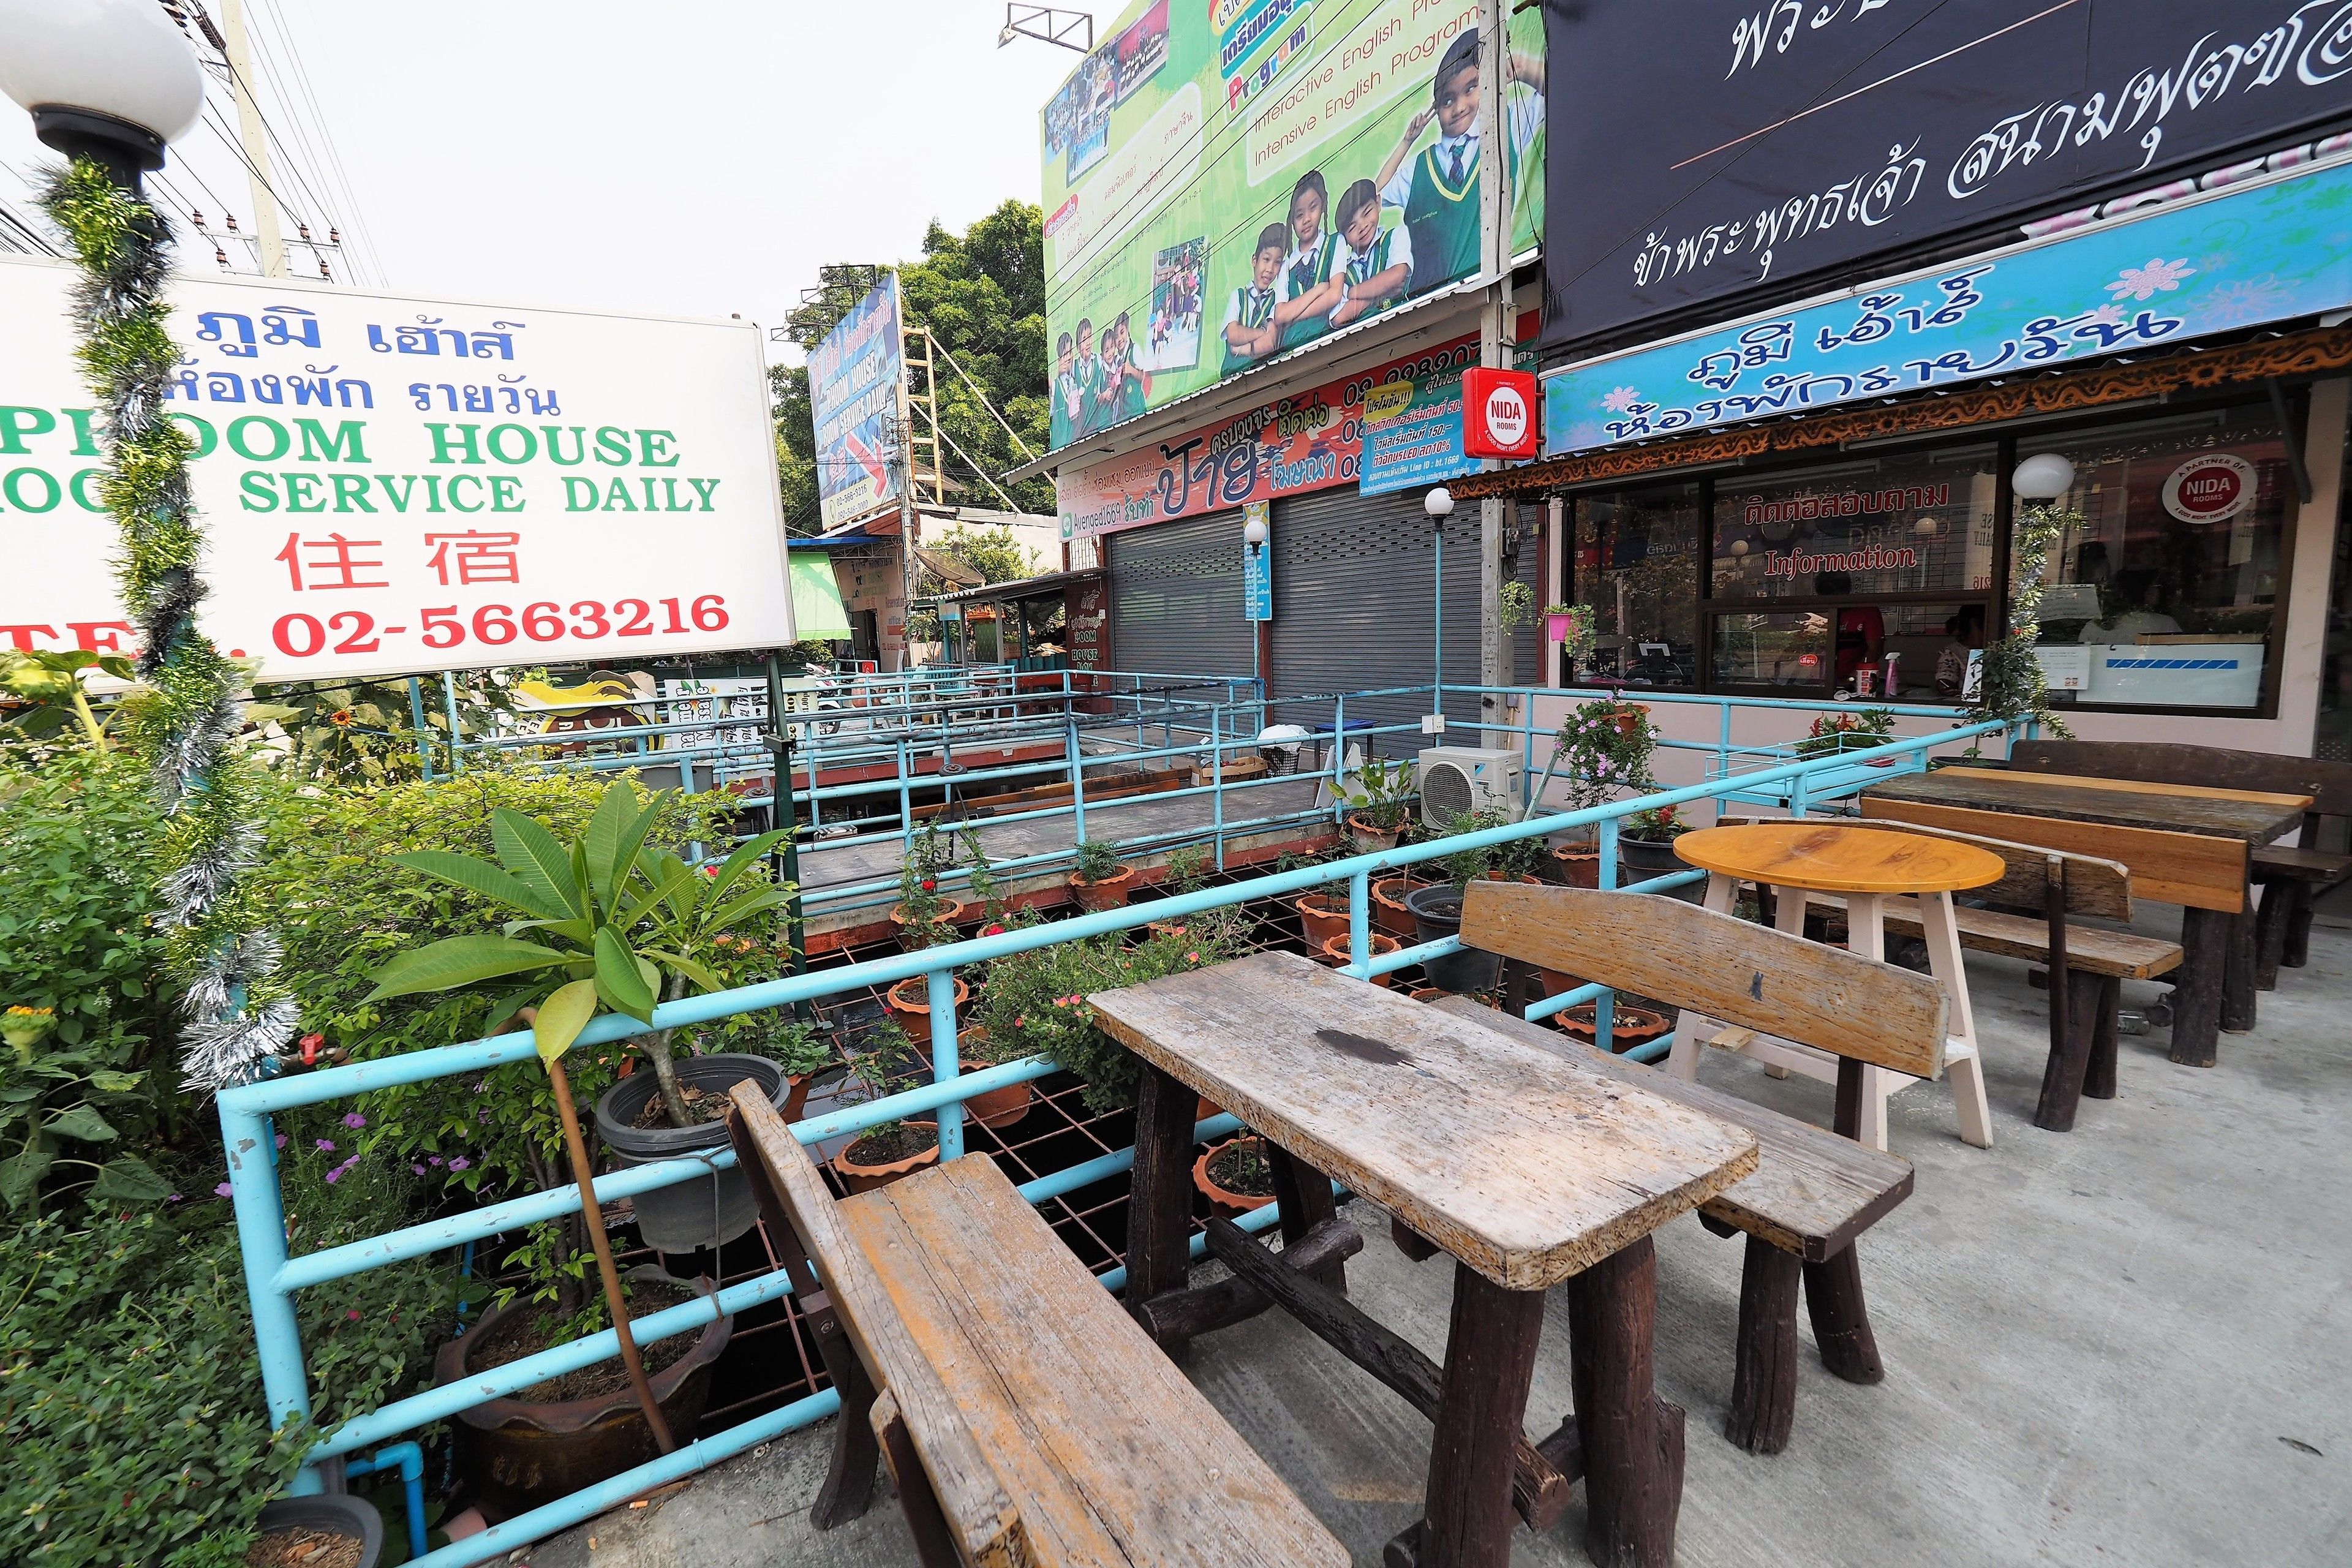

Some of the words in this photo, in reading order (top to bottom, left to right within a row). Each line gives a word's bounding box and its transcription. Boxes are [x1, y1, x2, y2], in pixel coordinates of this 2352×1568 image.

[1229, 26, 1305, 111] Program
[1255, 67, 1333, 133] Interactive
[1343, 18, 1401, 71] English
[1255, 116, 1316, 167] Intensive
[1325, 71, 1381, 119] English
[1392, 6, 1479, 75] Program
[196, 306, 322, 358] ภูมิ
[366, 314, 526, 360] เฮ้าส์
[162, 356, 374, 409] ห้องพัก
[408, 373, 562, 417] รายวัน
[826, 373, 850, 415] PHOOM
[851, 350, 876, 395] HOUSE
[1604, 311, 2183, 439] ห้องพักรายวัน
[822, 417, 840, 448] ROOM
[839, 396, 866, 437] SERVICE
[865, 380, 887, 419] DAILY
[1210, 405, 1273, 456] ครบวงจร
[1276, 393, 1330, 439] ติดต่อ
[1491, 400, 1521, 420] NIDA
[1496, 422, 1517, 431] ROOMS
[423, 422, 681, 467] HOUSE
[1486, 432, 1497, 446] GOOD
[1124, 459, 1156, 483] ออกแบบ
[1157, 436, 1256, 516] ป้าย
[1270, 452, 1337, 491] โฆษณา
[1409, 462, 1422, 472] Line
[1422, 461, 1430, 470] ID
[2185, 458, 2231, 472] PARTNER
[2186, 477, 2231, 496] NIDA
[238, 470, 527, 514] SERVICE
[560, 476, 721, 513] DAILY
[1744, 483, 1950, 526] ติดต่อสอบถาม
[2192, 494, 2223, 503] ROOMS
[1074, 502, 1121, 534] Avenged1669
[2178, 510, 2190, 518] GOOD
[1764, 543, 1917, 582] Information
[271, 595, 729, 658] 02-5663216
[1071, 648, 1098, 661] HOUSE
